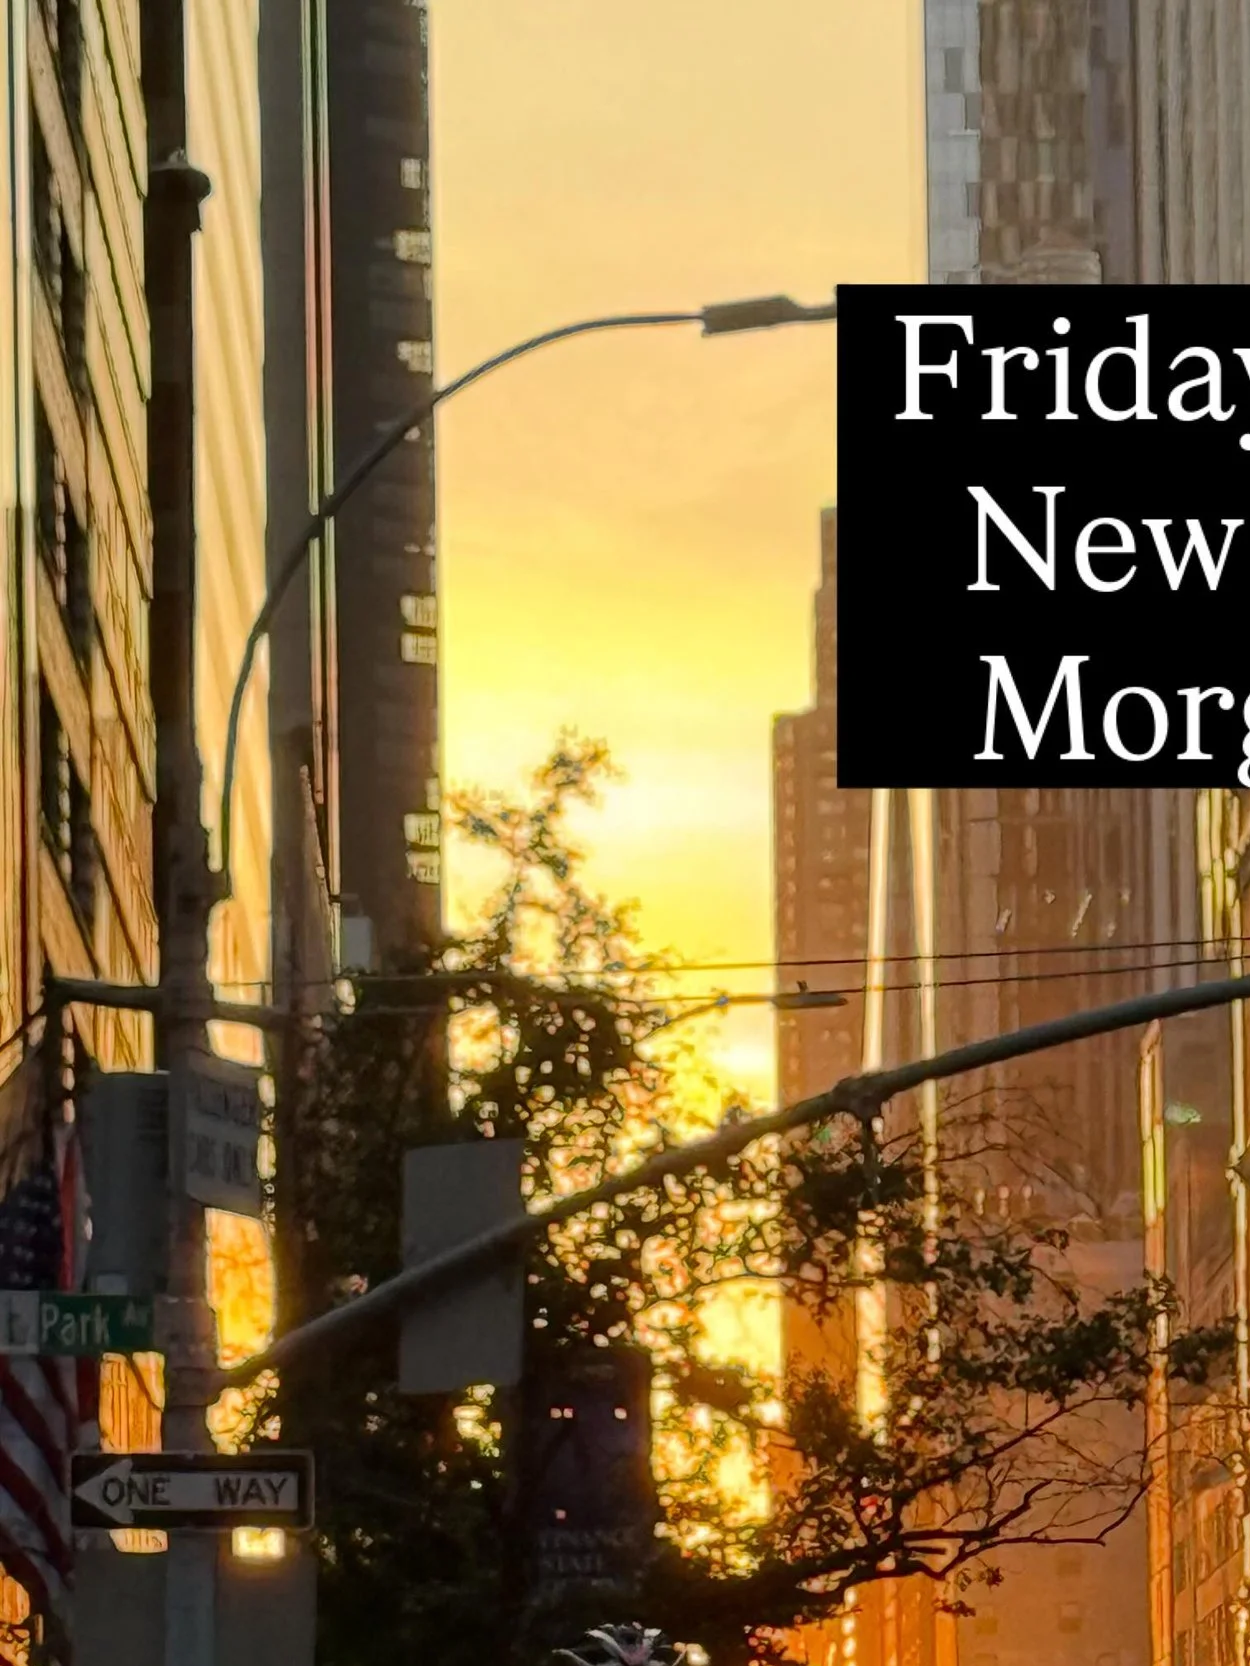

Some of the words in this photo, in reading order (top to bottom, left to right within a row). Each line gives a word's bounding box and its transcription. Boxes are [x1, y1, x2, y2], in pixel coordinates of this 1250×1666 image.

[41, 1302, 110, 1346] Park
[102, 1477, 172, 1507] ONE
[213, 1477, 290, 1506] WAY
